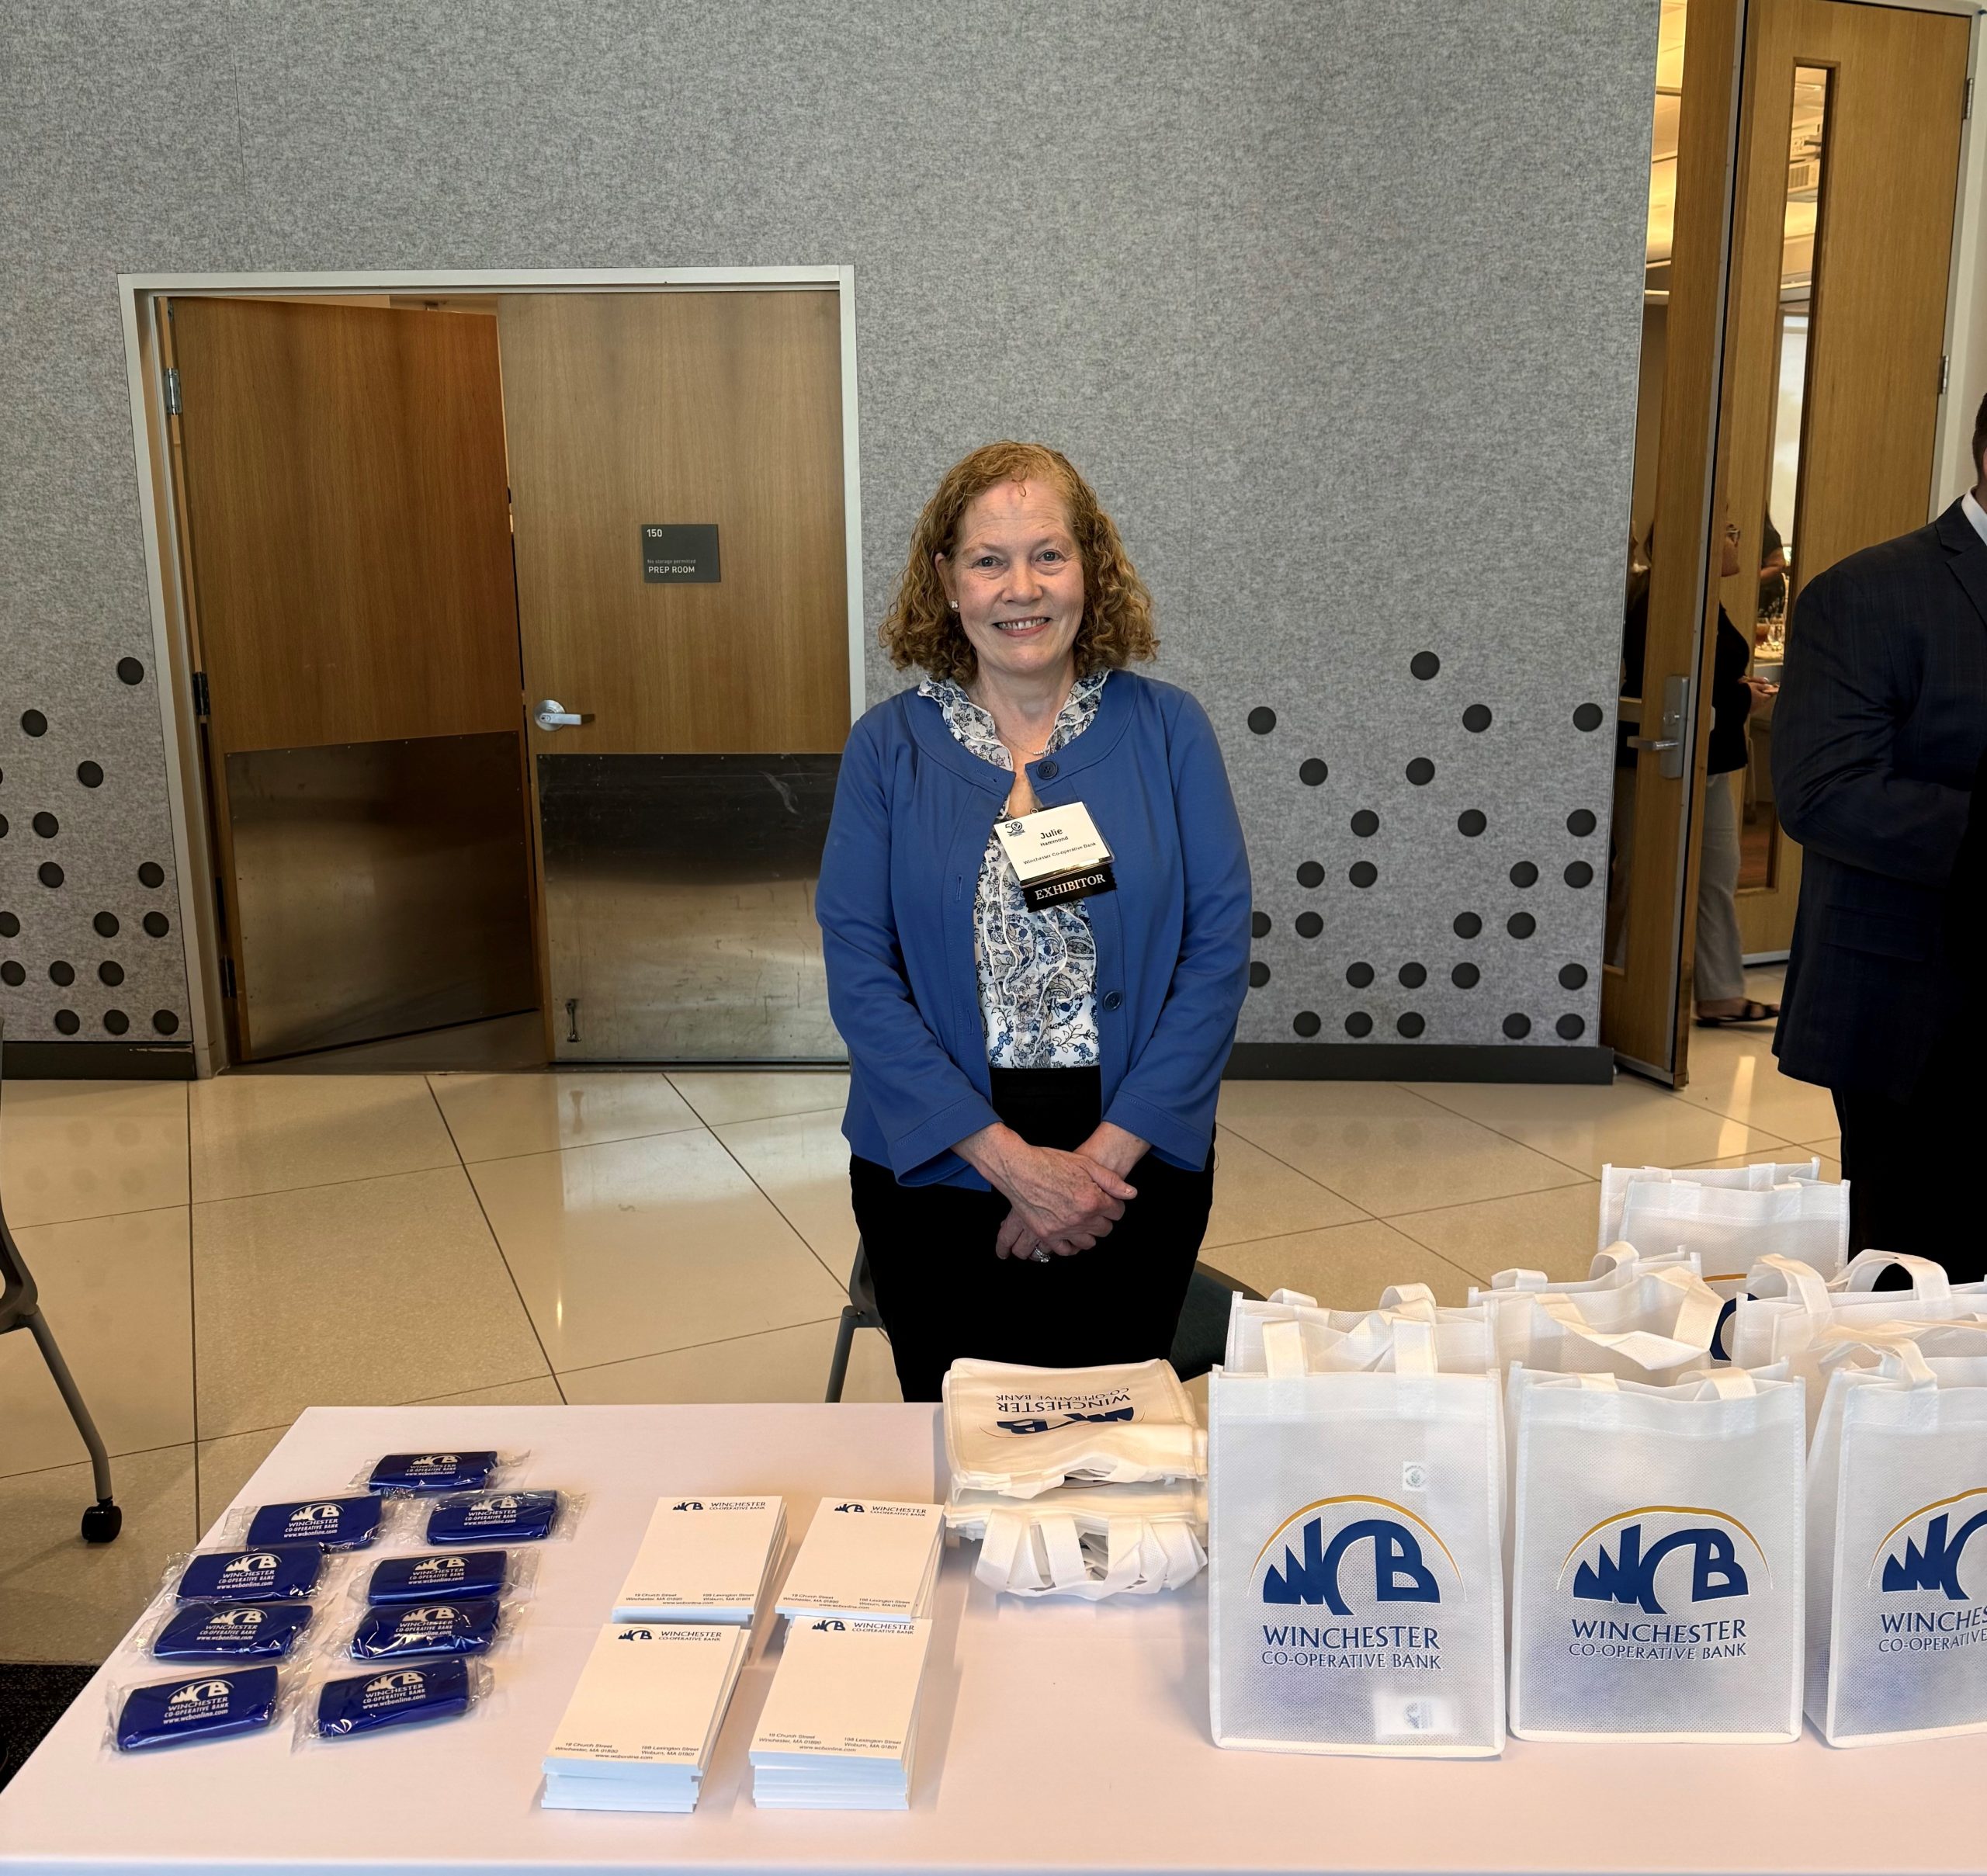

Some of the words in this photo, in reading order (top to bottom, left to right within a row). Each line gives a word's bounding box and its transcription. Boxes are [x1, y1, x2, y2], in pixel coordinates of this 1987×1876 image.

[647, 529, 663, 537] 150
[1040, 828, 1063, 839] Julie
[1023, 854, 1051, 865] Winchester
[1035, 873, 1106, 900] EXHIBITOR
[1037, 1388, 1129, 1401] CO-OPERATIVE
[997, 1394, 1131, 1413] WINCHESTER
[1263, 1517, 1441, 1615] WCB
[1573, 1524, 1749, 1615] WCB
[223, 1570, 275, 1579] WINCHESTER
[1263, 1625, 1441, 1649] WINCHESTER
[1571, 1619, 1746, 1643] WINCHESTER
[1569, 1644, 1695, 1659] CO-OPERATIVE
[1702, 1642, 1746, 1659] BANK
[1262, 1651, 1385, 1668] CO-OPERATIVE
[1393, 1653, 1441, 1669] BANK
[362, 1692, 406, 1704] CO-OPERATIVE
[366, 1684, 424, 1698] WINCHESTER
[168, 1697, 227, 1711] WINCHESTER
[164, 1706, 209, 1718] CO-OPERATIVE
